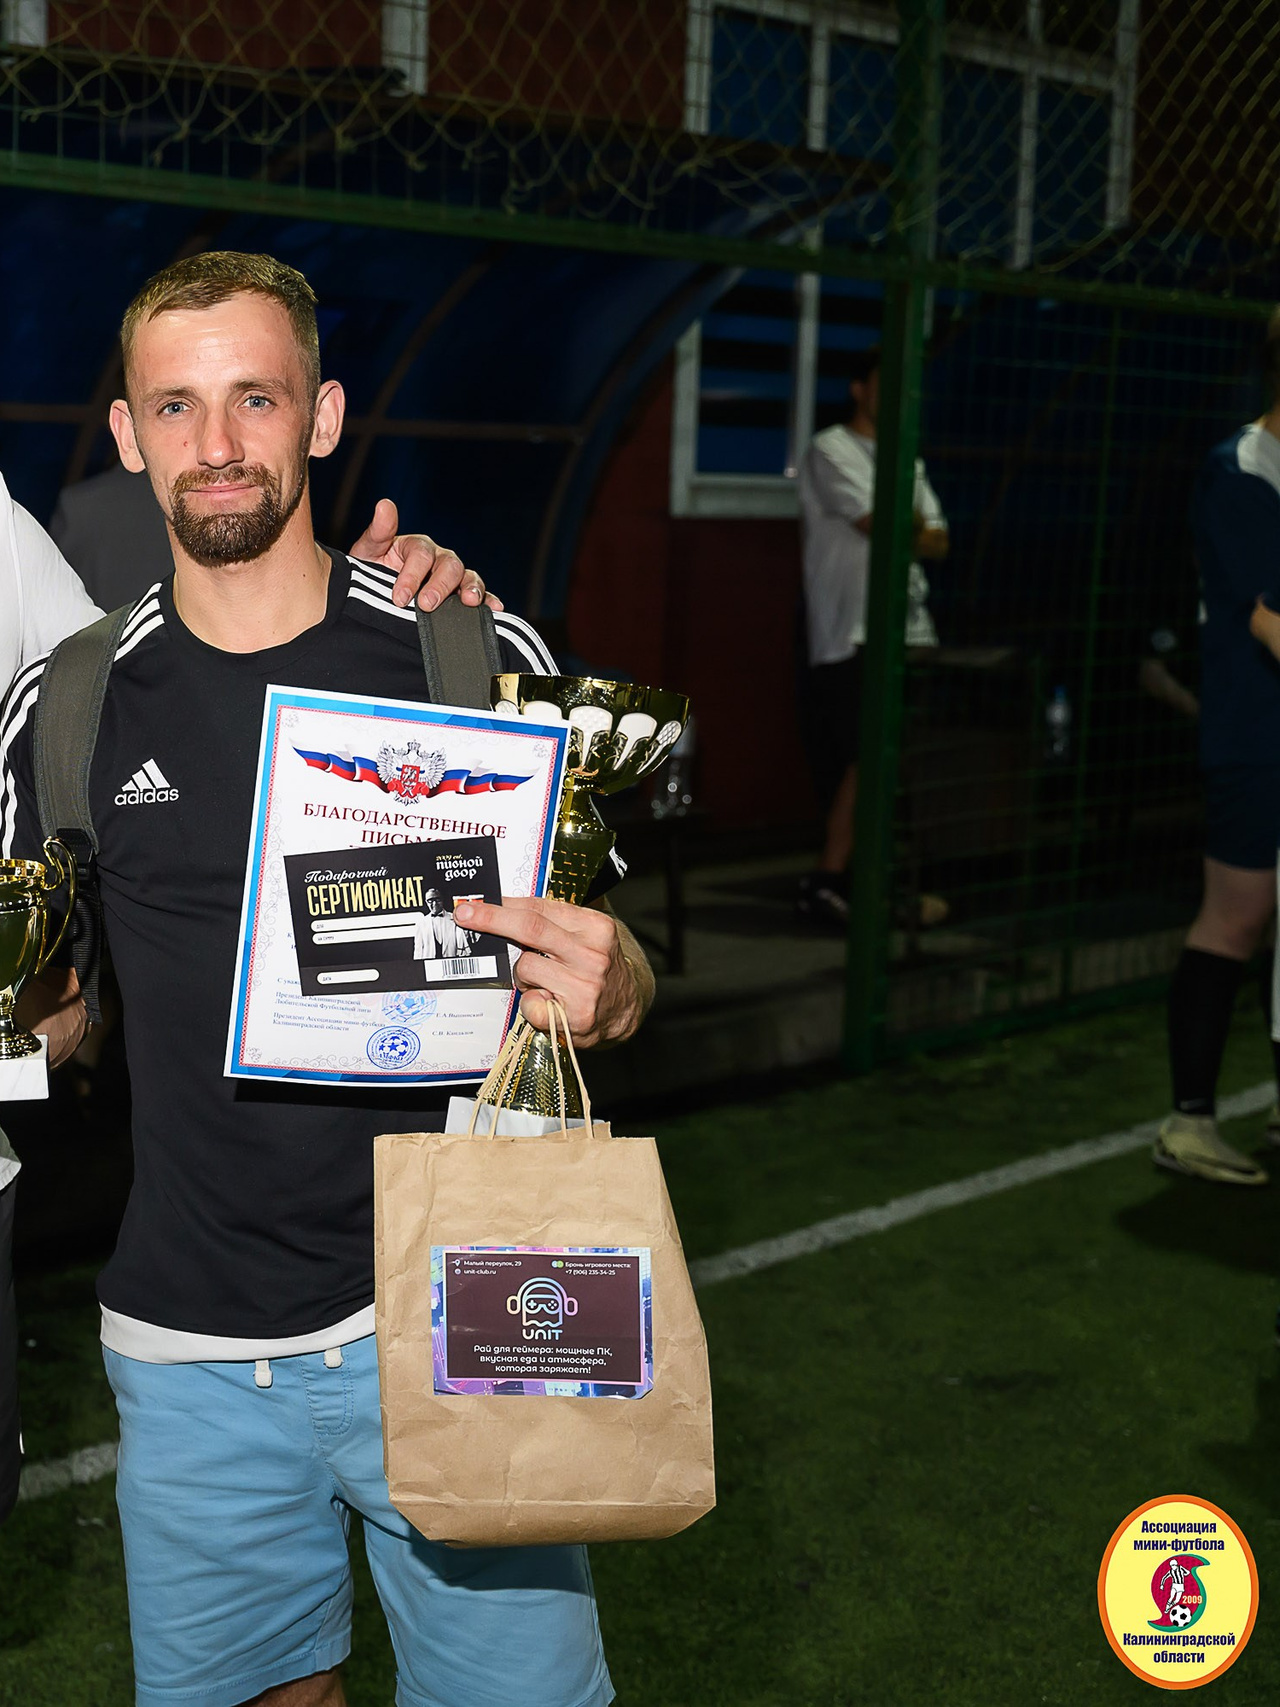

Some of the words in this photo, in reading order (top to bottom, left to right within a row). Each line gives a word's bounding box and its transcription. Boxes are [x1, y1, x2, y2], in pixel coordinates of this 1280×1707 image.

[114, 788, 180, 806] adidas
[303, 802, 508, 839] БЛАГОДАРСТВЕННОЕ
[435, 856, 484, 870] пивной
[304, 866, 389, 884] Подарочный
[444, 868, 477, 882] двор
[306, 875, 425, 917] СЕРТИФИКАТ
[473, 1344, 492, 1353] Рай
[493, 1345, 511, 1354] для
[512, 1345, 554, 1355] геймера:
[555, 1347, 595, 1355] мощные
[596, 1347, 613, 1357] ПК,
[479, 1355, 519, 1364] вкусная
[520, 1356, 538, 1364] еда
[547, 1356, 607, 1366] атмосфера,
[495, 1365, 538, 1373] которая
[538, 1366, 592, 1374] заряжает!
